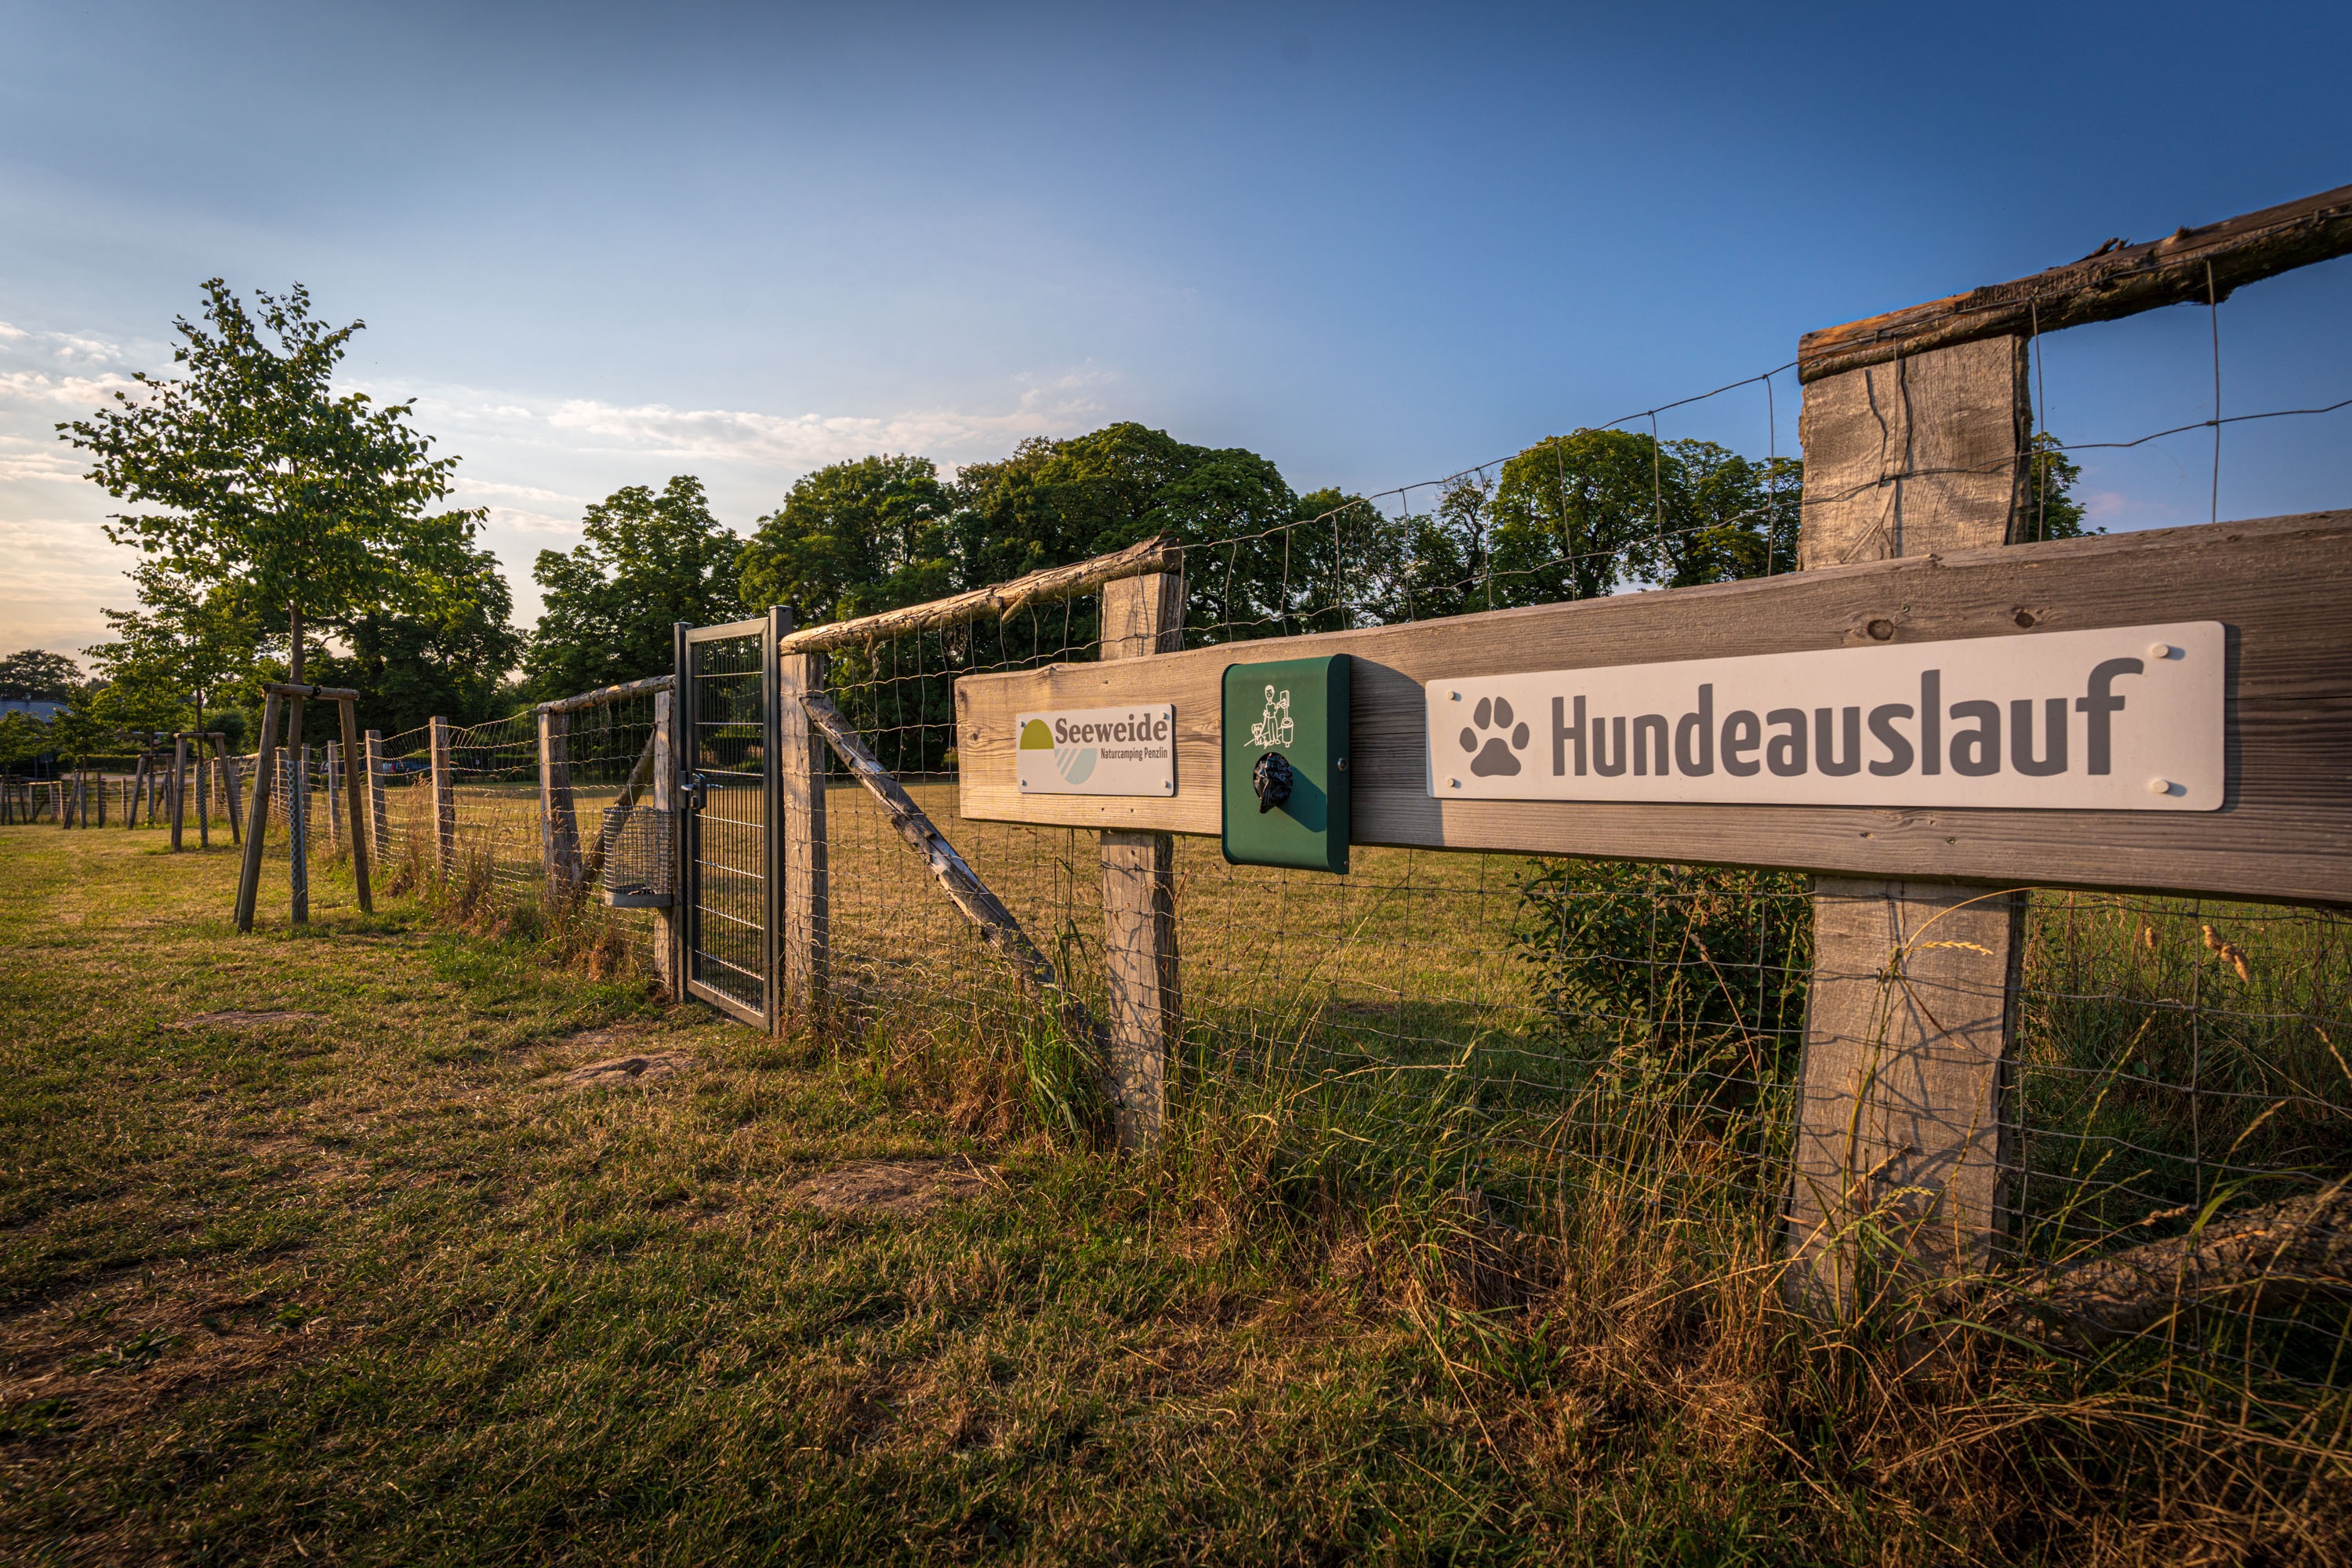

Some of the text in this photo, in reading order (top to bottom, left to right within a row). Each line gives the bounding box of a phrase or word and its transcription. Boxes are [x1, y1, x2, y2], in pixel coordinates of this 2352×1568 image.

[1055, 713, 1168, 743] Seeweide
[1552, 657, 2145, 778] Hundeauslauf
[1101, 746, 1168, 761] Naturcamping Penzlin
